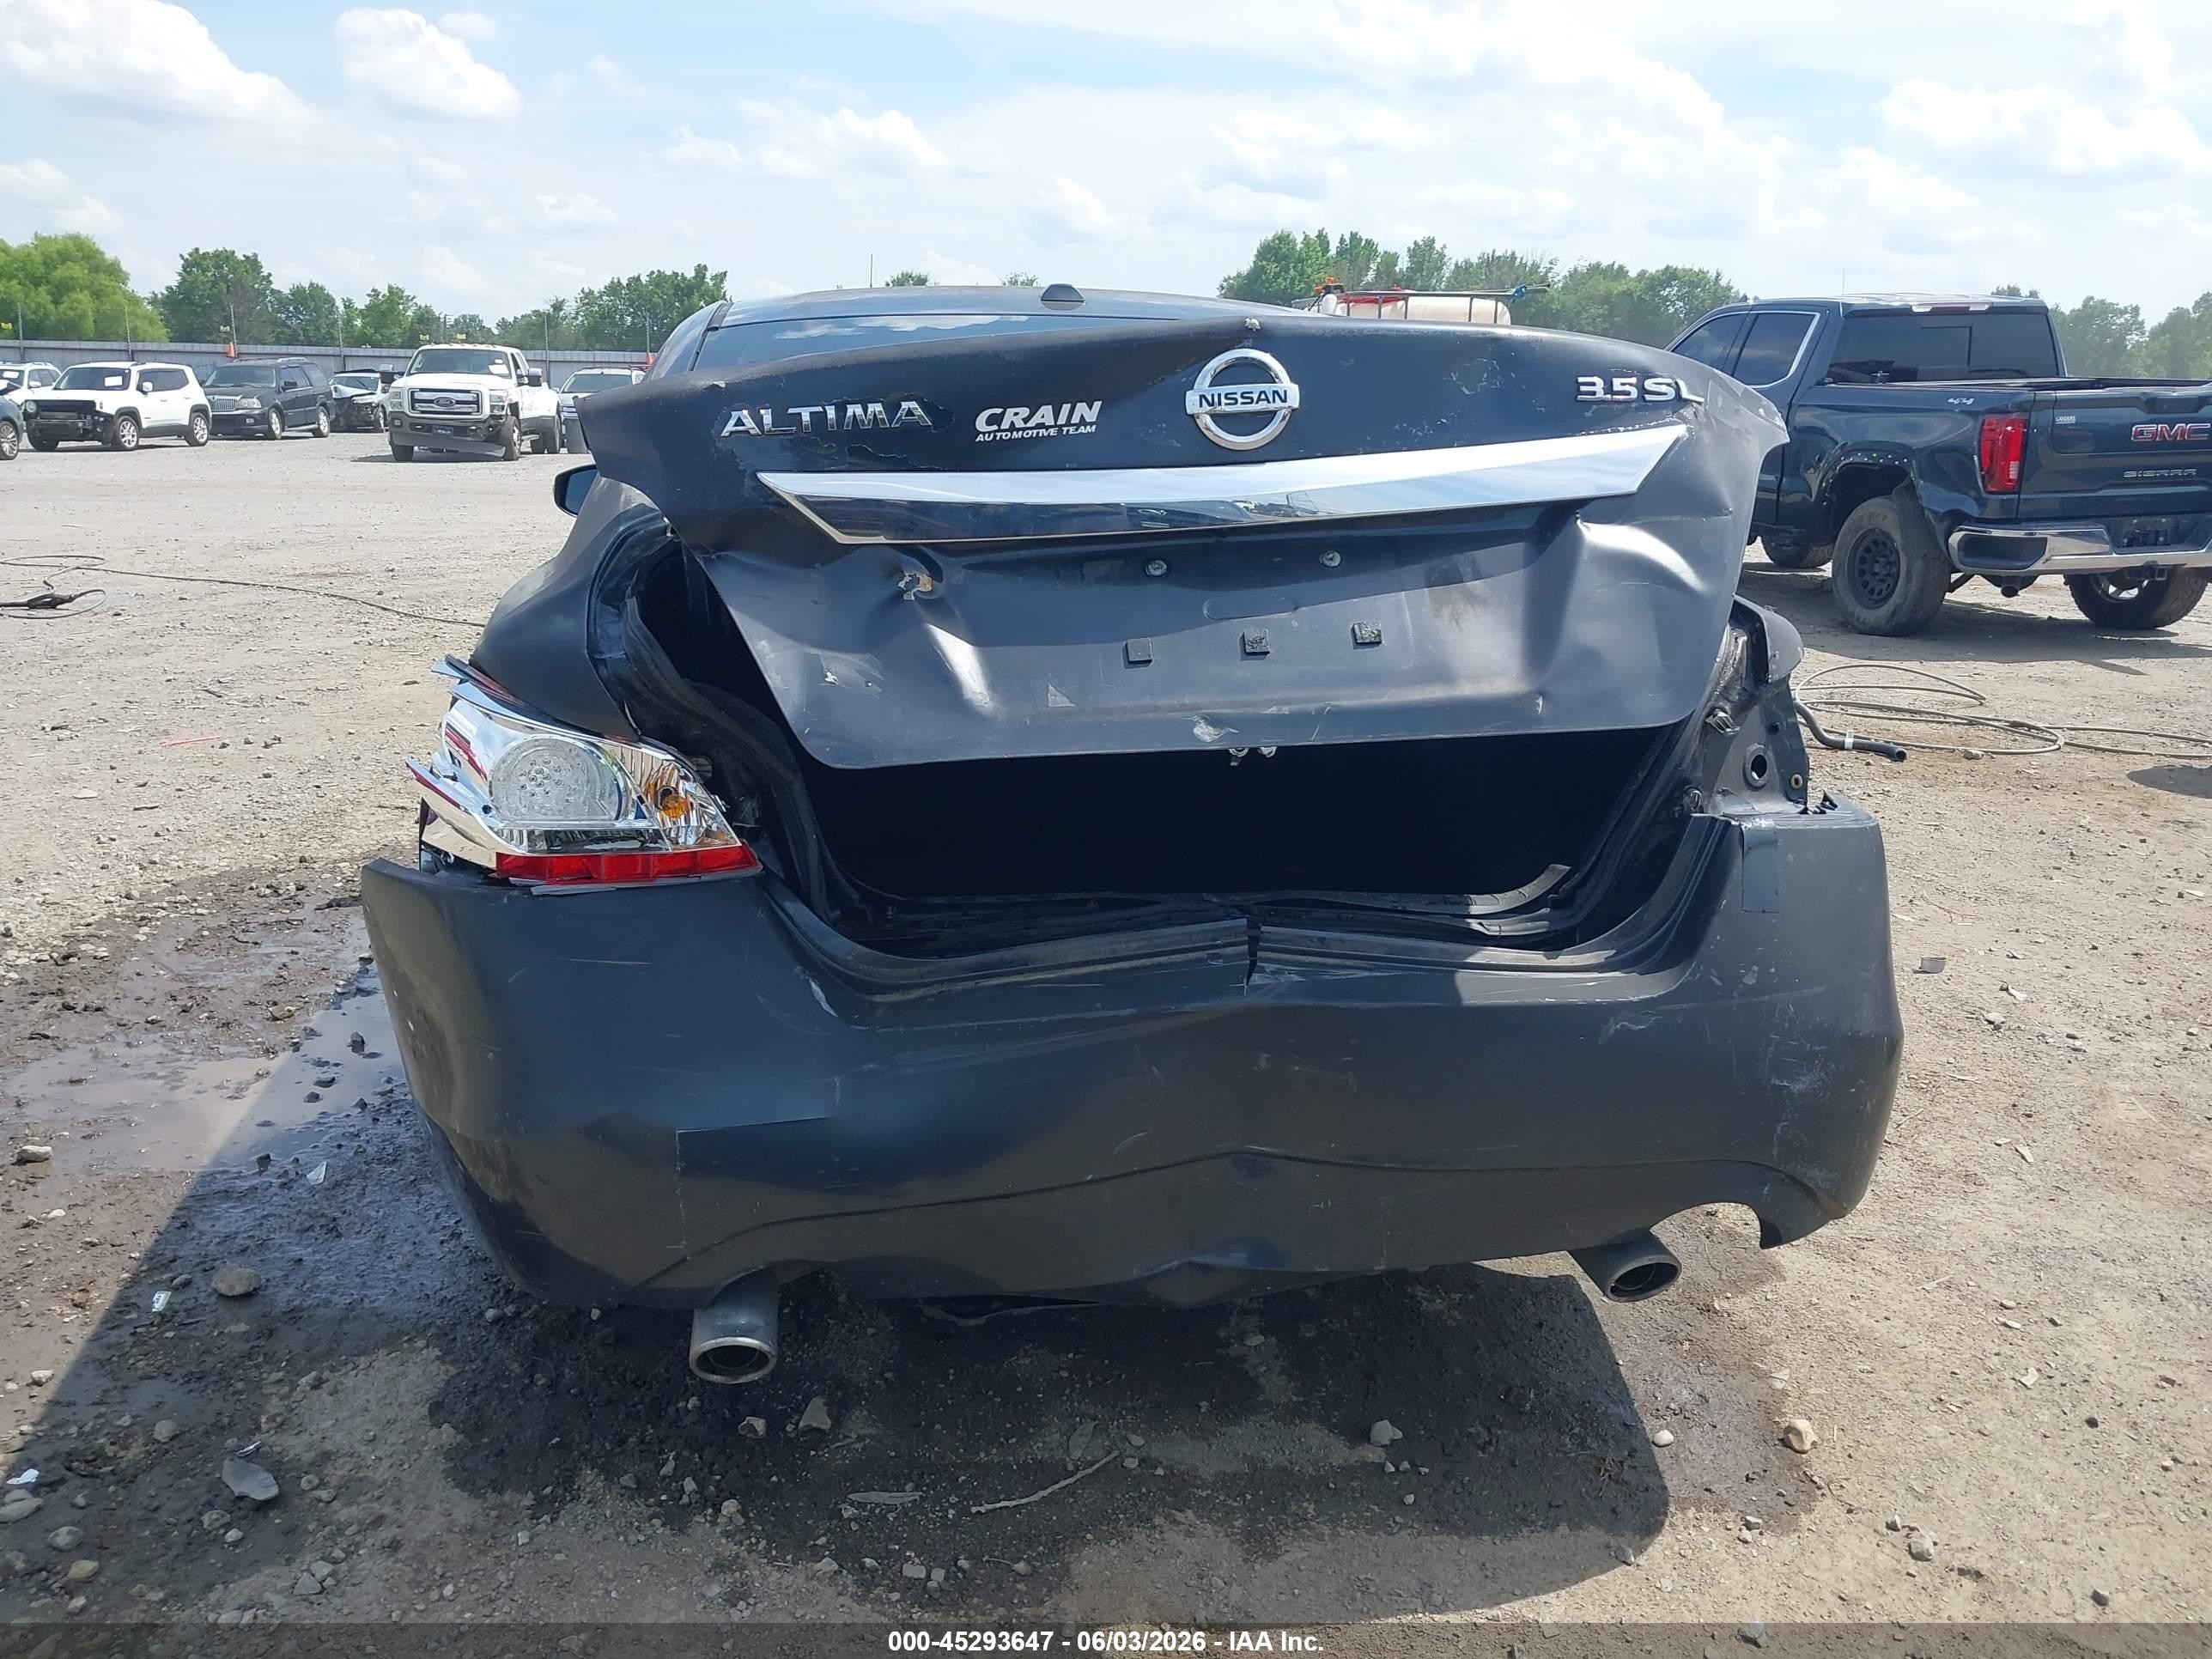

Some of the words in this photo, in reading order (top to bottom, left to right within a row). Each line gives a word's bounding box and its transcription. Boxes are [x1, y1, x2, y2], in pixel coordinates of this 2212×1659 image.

[1199, 389, 1288, 409] NISSAN
[720, 400, 933, 437] ALTIMA
[975, 400, 1103, 433] CRAIN
[975, 427, 1059, 442] AUTOMOTIVE
[1061, 424, 1097, 435] TEAM
[2130, 422, 2211, 442] GMC
[2122, 468, 2198, 478] SIERRA
